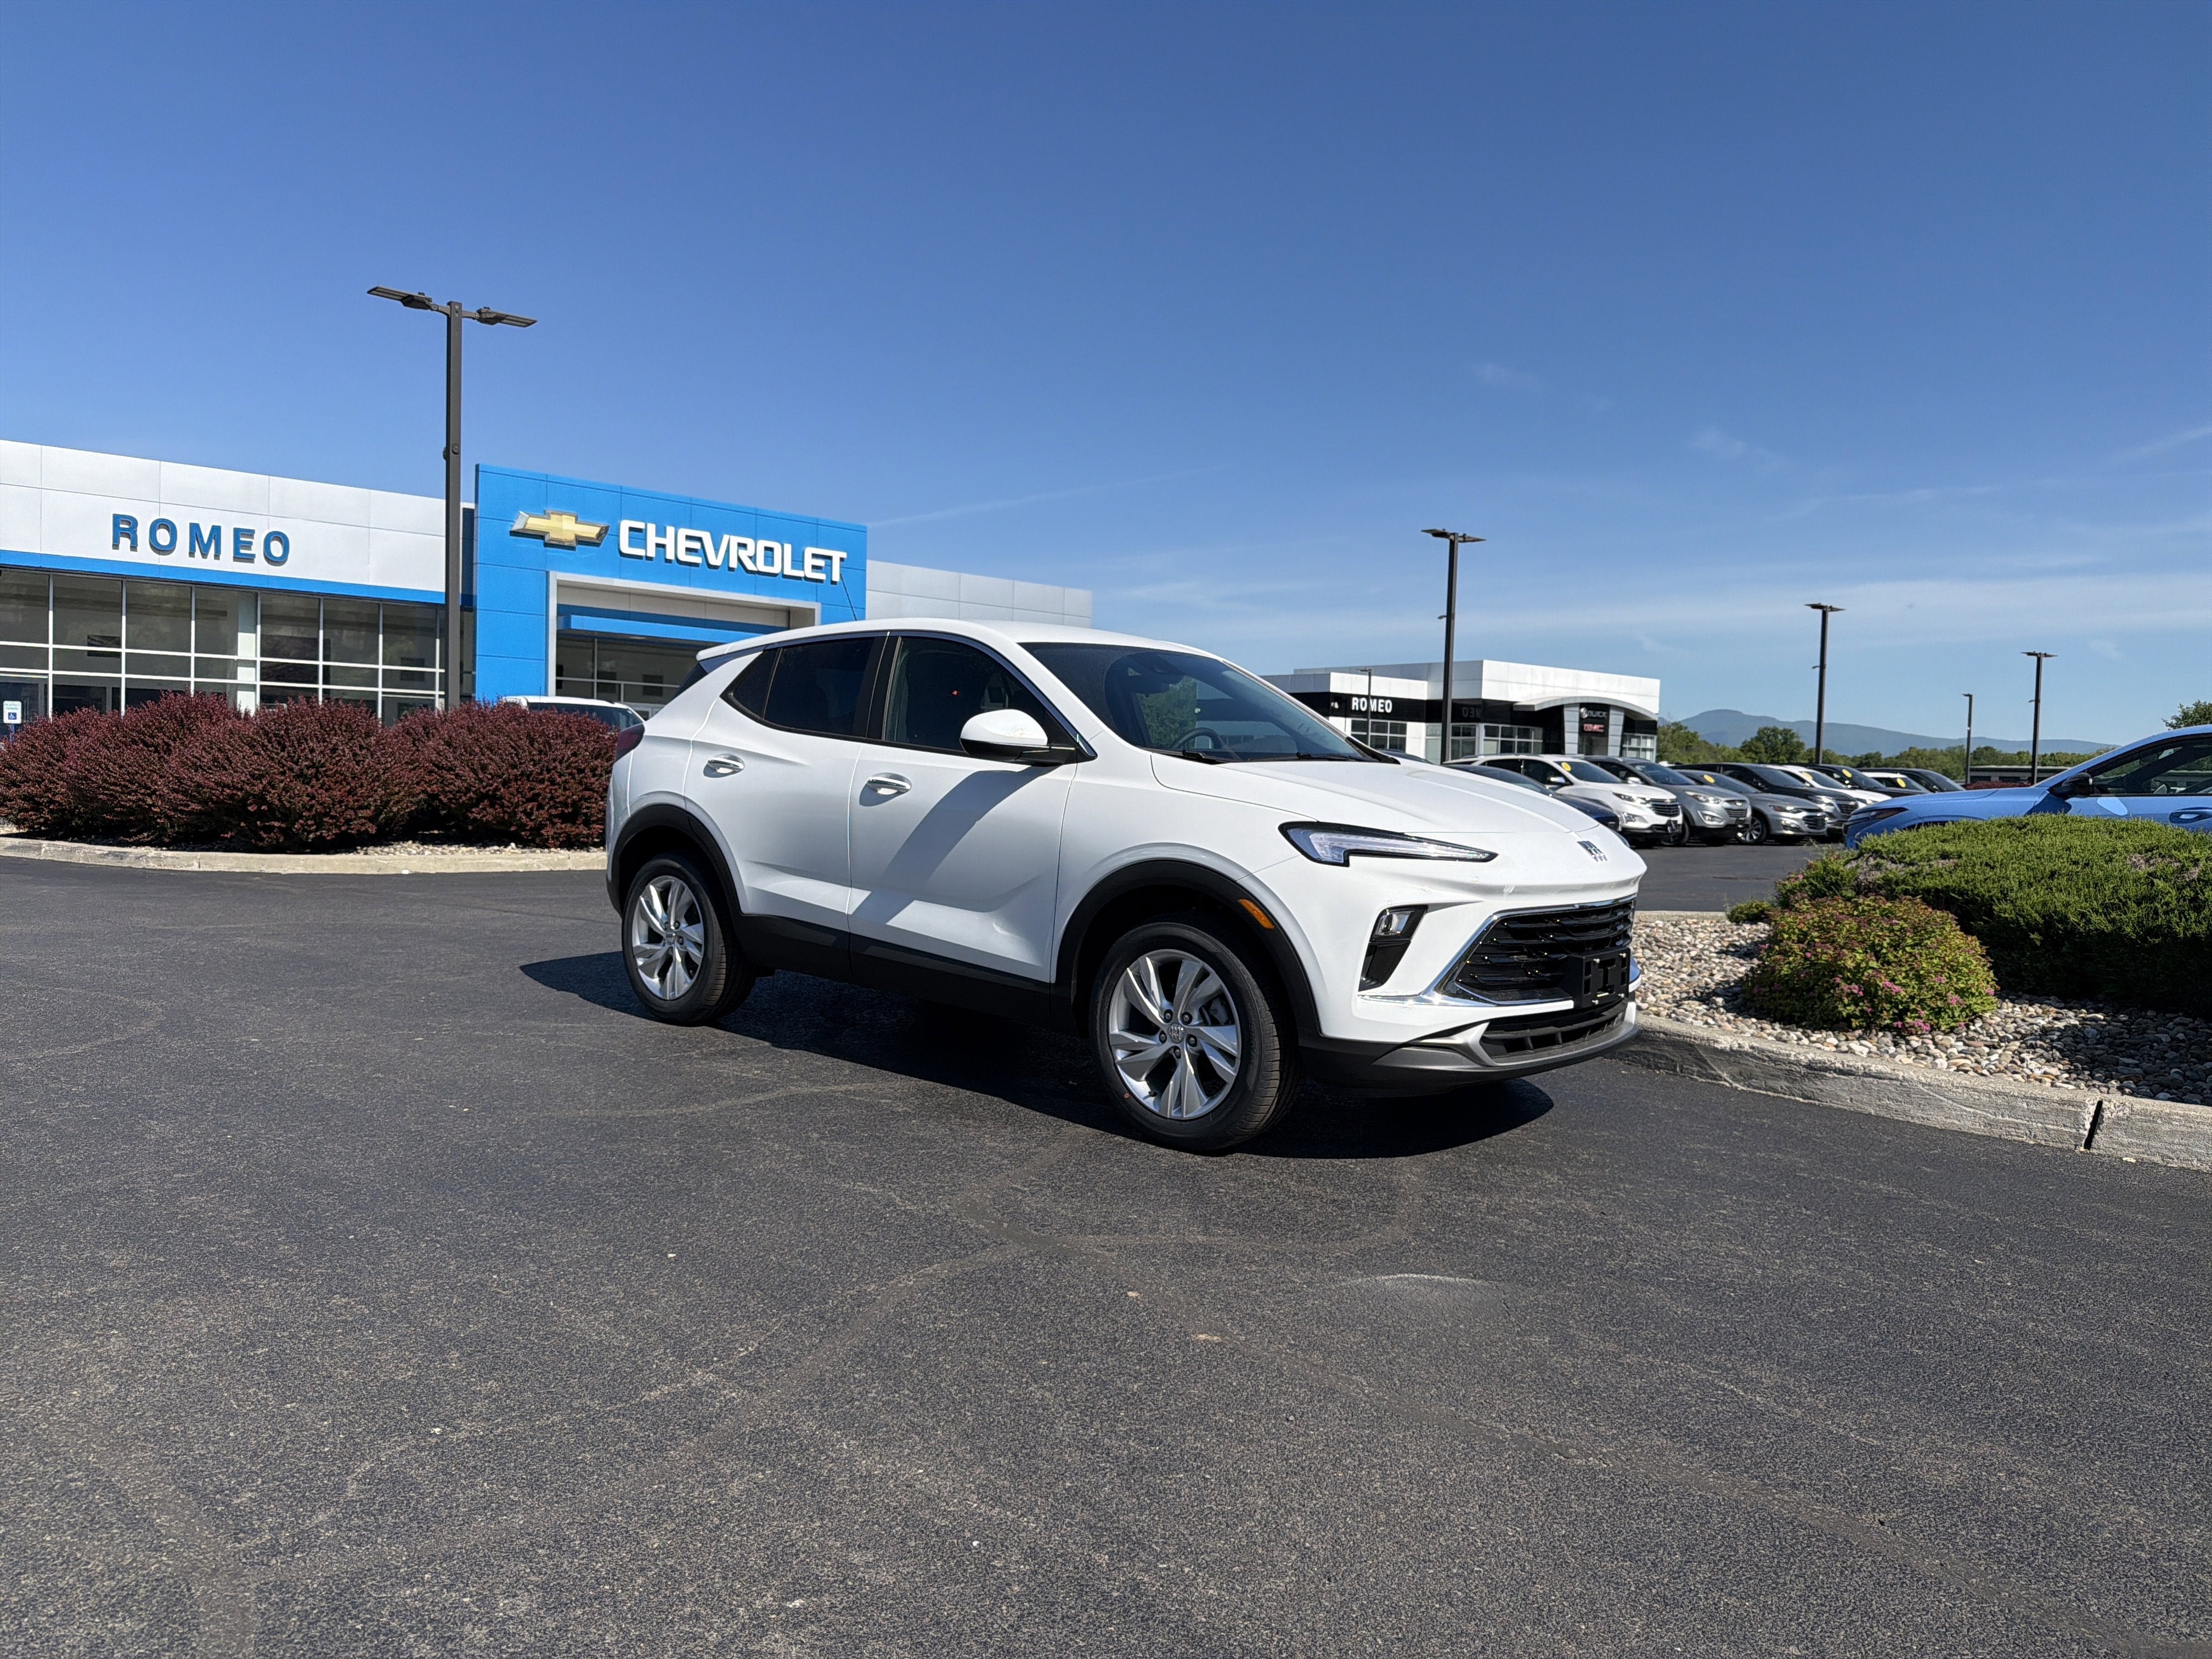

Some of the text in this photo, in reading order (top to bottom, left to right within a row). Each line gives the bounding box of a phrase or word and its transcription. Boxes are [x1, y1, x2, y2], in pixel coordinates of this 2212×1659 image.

[112, 514, 290, 566] ROMEO
[619, 520, 847, 583] CHEVROLET
[1352, 697, 1392, 713] ROMEO
[1583, 724, 1605, 733] GMC
